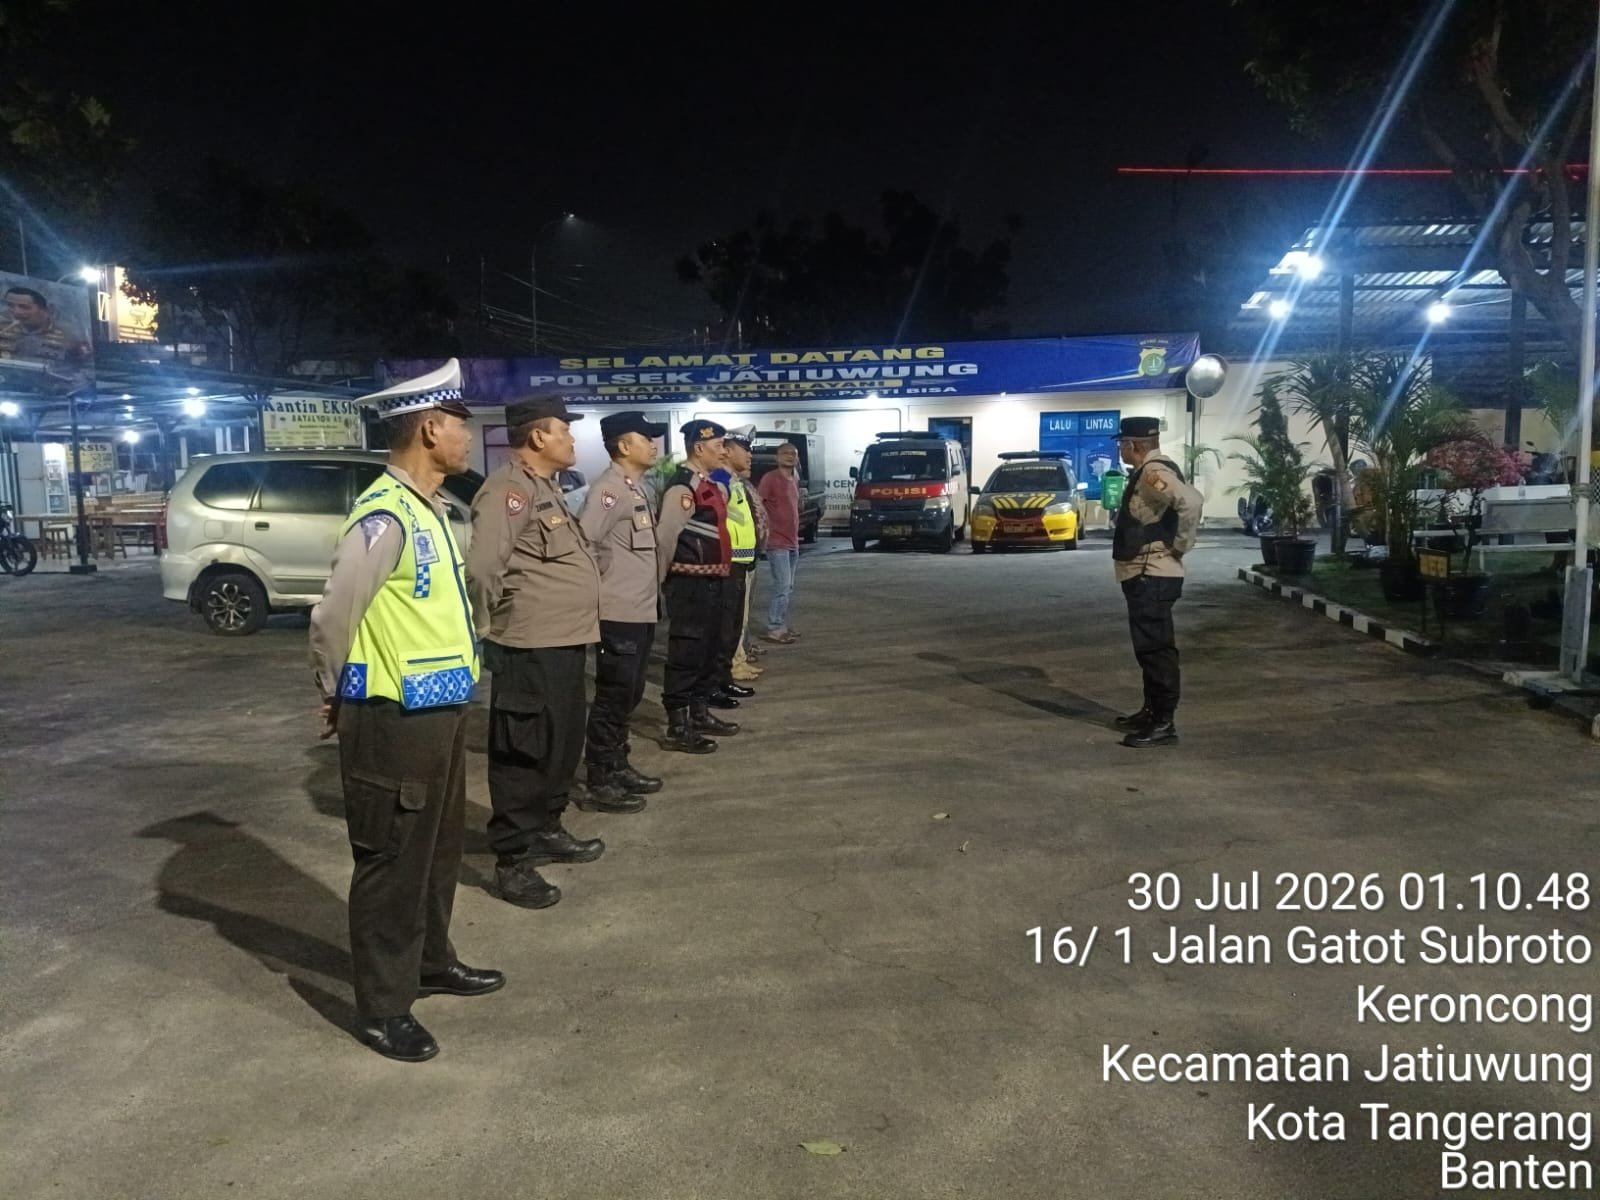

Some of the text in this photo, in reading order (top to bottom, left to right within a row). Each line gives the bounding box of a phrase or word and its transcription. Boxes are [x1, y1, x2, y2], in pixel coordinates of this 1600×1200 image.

[559, 346, 945, 370] SELAMAT DATANG
[529, 362, 979, 387] POLSEK JATIUWUNG
[756, 381, 885, 391] MELAYANI
[906, 386, 958, 394] BISA
[263, 396, 318, 414] Kantin
[1049, 418, 1114, 431] LALU LINTAS
[870, 487, 928, 496] POLISI
